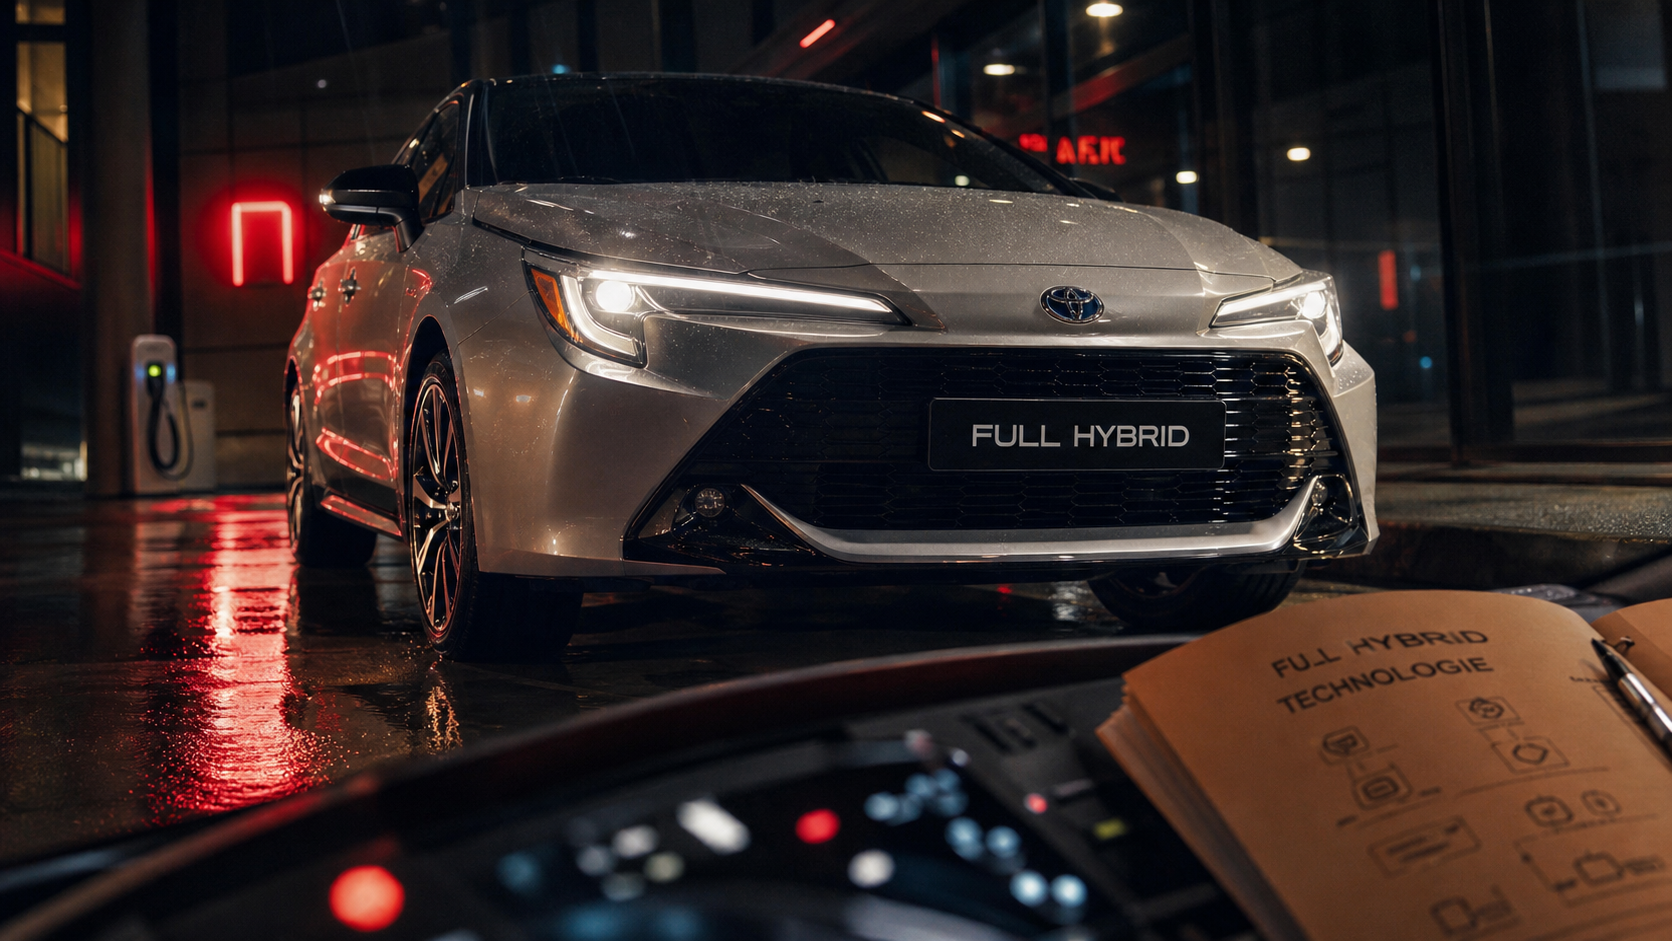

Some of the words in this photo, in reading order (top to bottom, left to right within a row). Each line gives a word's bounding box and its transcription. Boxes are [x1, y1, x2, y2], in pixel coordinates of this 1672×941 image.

[971, 424, 1061, 447] FULL
[1074, 425, 1190, 447] HYBRID
[1346, 630, 1489, 657] HYBRID
[1276, 657, 1495, 714] TECHNOLOGIE
